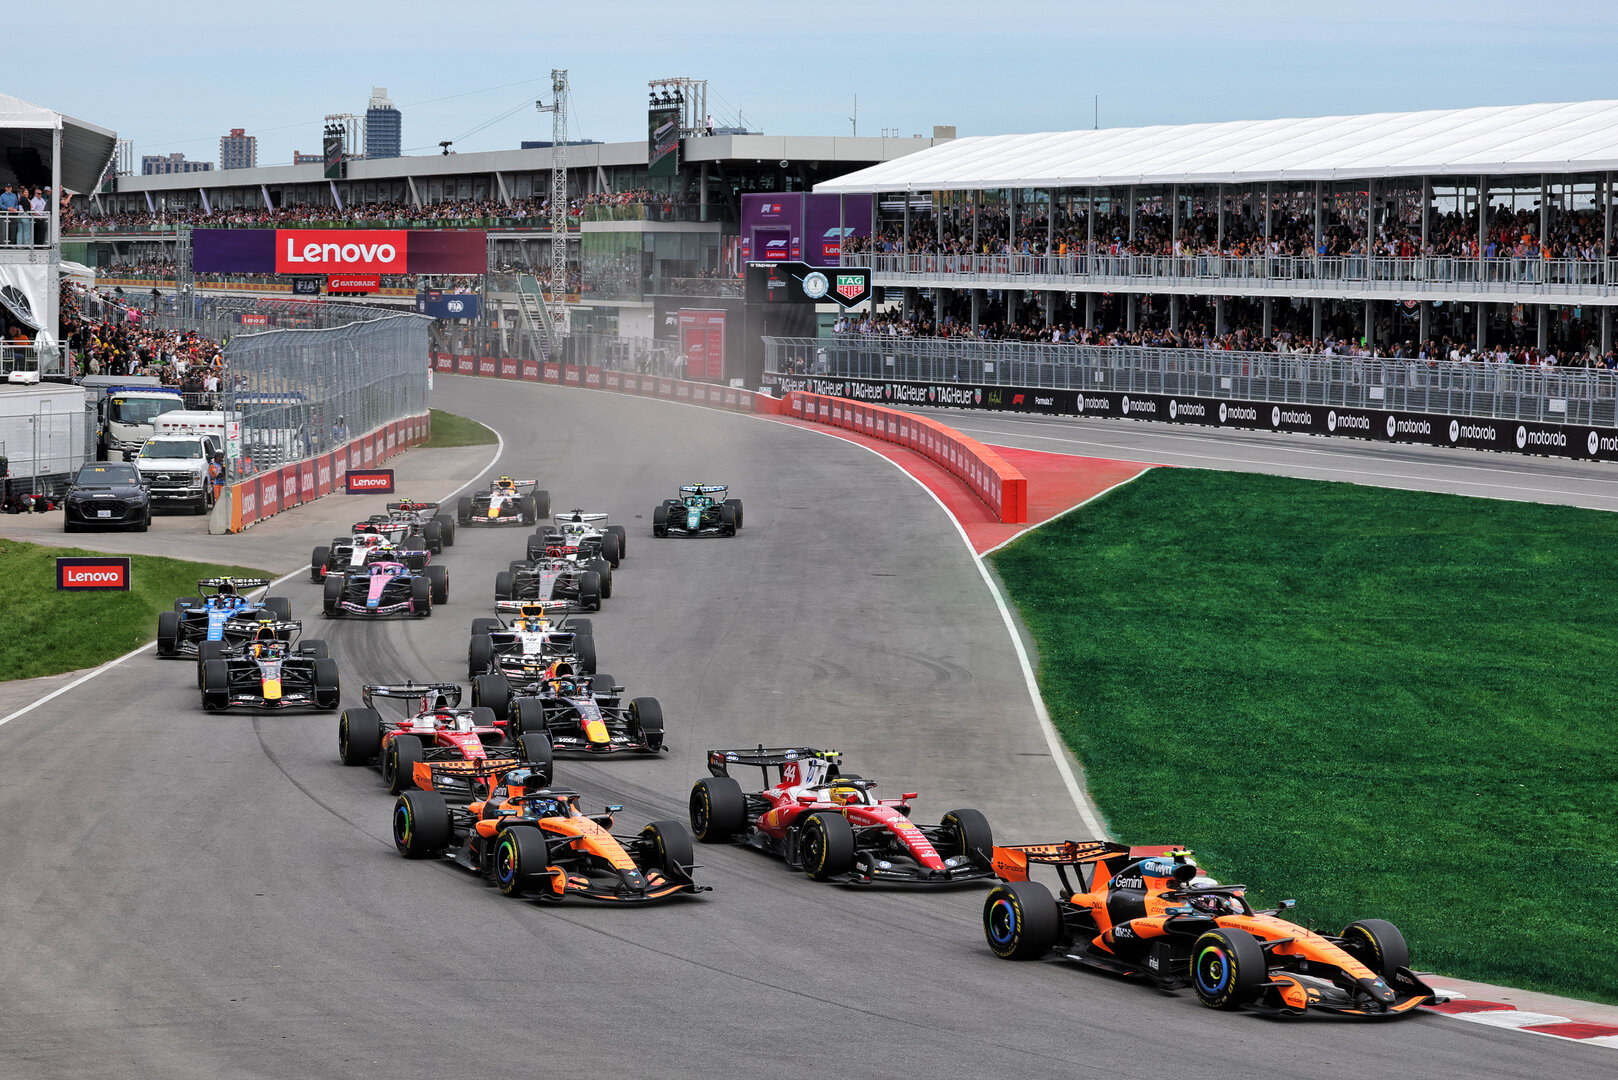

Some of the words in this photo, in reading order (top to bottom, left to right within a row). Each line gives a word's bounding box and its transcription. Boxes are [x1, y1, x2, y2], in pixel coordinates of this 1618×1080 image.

[288, 238, 396, 262] Lenovo
[298, 280, 315, 290] FIA
[838, 286, 863, 298] HEUER
[438, 358, 451, 368] Lenovo
[459, 359, 473, 370] Lenovo
[480, 360, 494, 372] Lenovo
[502, 363, 516, 374] Lenovo
[524, 364, 537, 376] Lenovo
[545, 367, 558, 379] Lenovo
[813, 380, 844, 396] TAGHeuer
[852, 382, 883, 399] TAGHeuer
[893, 384, 927, 402] TAGHeuer
[937, 387, 973, 404] TAGHeuer
[1085, 398, 1109, 410] motorola
[1130, 400, 1156, 412] motorola
[1178, 403, 1205, 416] motorola
[1228, 407, 1256, 420] motorola
[1282, 411, 1311, 424] motorola
[1338, 415, 1369, 430] motorola
[1397, 420, 1430, 434] motorola
[1460, 426, 1496, 441] motorola
[1528, 430, 1566, 446] motorola
[352, 450, 361, 469] Lenovo
[336, 458, 346, 478] Lenovo
[302, 470, 314, 492] Lenovo
[319, 465, 330, 486] Lenovo
[353, 478, 386, 487] Lenovo
[284, 475, 296, 497] Lenovo
[263, 483, 277, 506] Lenovo
[242, 492, 255, 515] Lenovo
[68, 571, 118, 582] Lenovo
[784, 764, 796, 782] 44
[1004, 864, 1024, 872] Dropbox
[1116, 875, 1142, 889] Gemini
[1155, 880, 1161, 889] E
